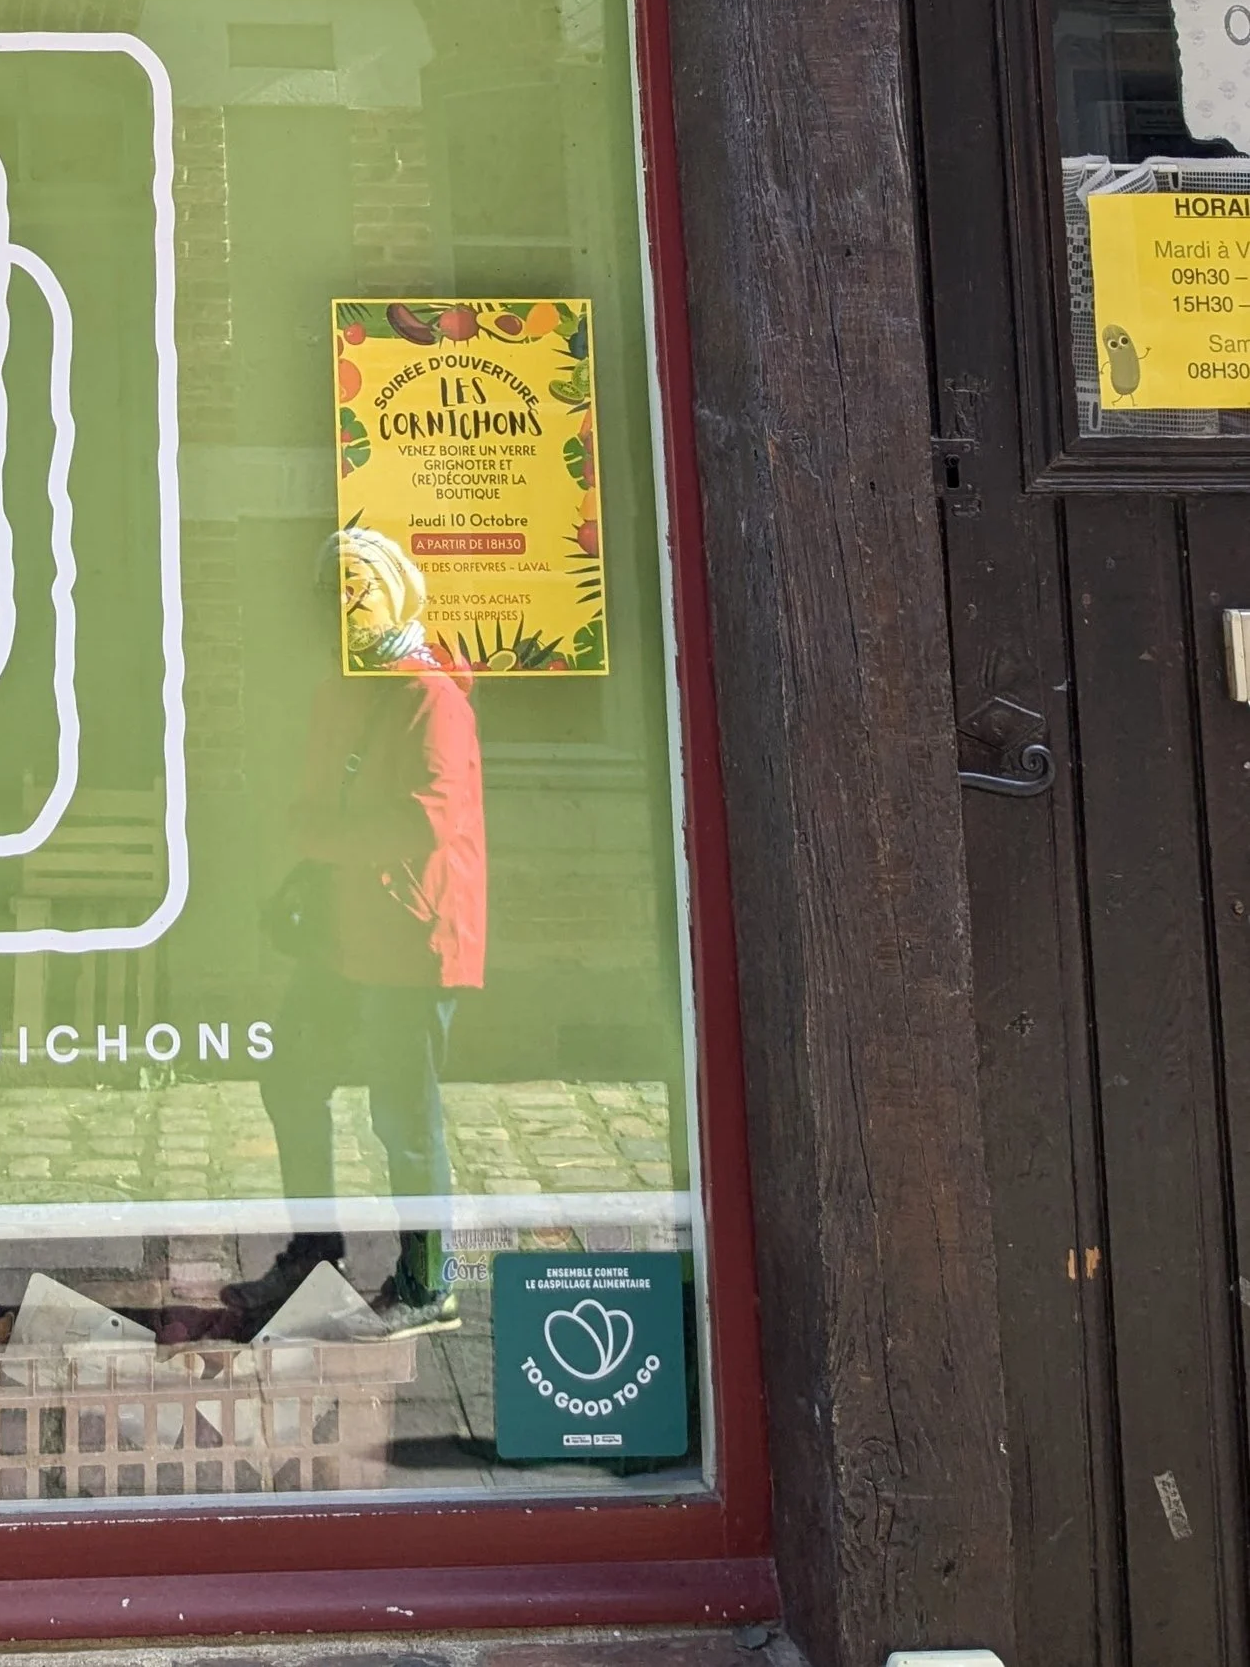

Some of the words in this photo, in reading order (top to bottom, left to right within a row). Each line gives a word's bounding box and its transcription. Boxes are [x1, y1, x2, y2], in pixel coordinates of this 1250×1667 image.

[1155, 240, 1210, 259] Mardi
[1217, 240, 1230, 259] à
[1171, 268, 1230, 285] 09h30
[1172, 296, 1234, 313] 15H30
[1187, 362, 1250, 380] 08H30
[374, 362, 427, 411] SOIRÉE
[428, 354, 540, 410] D'OUVERTURE
[440, 376, 487, 408] LES
[379, 408, 543, 441] CORNICHONS
[398, 445, 436, 456] VENEZ
[440, 445, 476, 456] BOIRE
[479, 445, 496, 456] UN
[499, 445, 537, 456] VERRE
[424, 459, 496, 471] GRIGNOTER
[500, 459, 513, 471] ET
[412, 471, 508, 488] (RE)DÉCOUVRIR
[511, 474, 527, 485] LA
[436, 488, 501, 500] BOUTIQUE
[408, 514, 447, 527] Jeudi
[451, 514, 466, 527] 10
[469, 514, 529, 527] Octobre
[416, 539, 425, 550] A
[427, 539, 466, 550] PARTIR
[469, 539, 483, 550] DE
[486, 539, 522, 550] 18H30
[432, 562, 451, 573] DES
[453, 562, 506, 573] ORFEVRES
[517, 561, 552, 573] LAVAL
[439, 594, 460, 605] SUR
[462, 594, 486, 605] VOS
[488, 594, 532, 605] ACHATS
[427, 611, 440, 621] ET
[442, 611, 462, 621] DES
[463, 611, 518, 621] SURPRISES
[546, 1268, 592, 1278] ENSEMBLE
[595, 1267, 629, 1277] CONTRE
[525, 1279, 536, 1290] LE
[538, 1279, 591, 1289] GASPILLAGE
[593, 1278, 651, 1289] ALIMENTAIRE
[520, 1356, 554, 1397] TOO
[554, 1391, 613, 1417] GOOD
[613, 1383, 639, 1406] TO
[636, 1354, 661, 1384] GO
